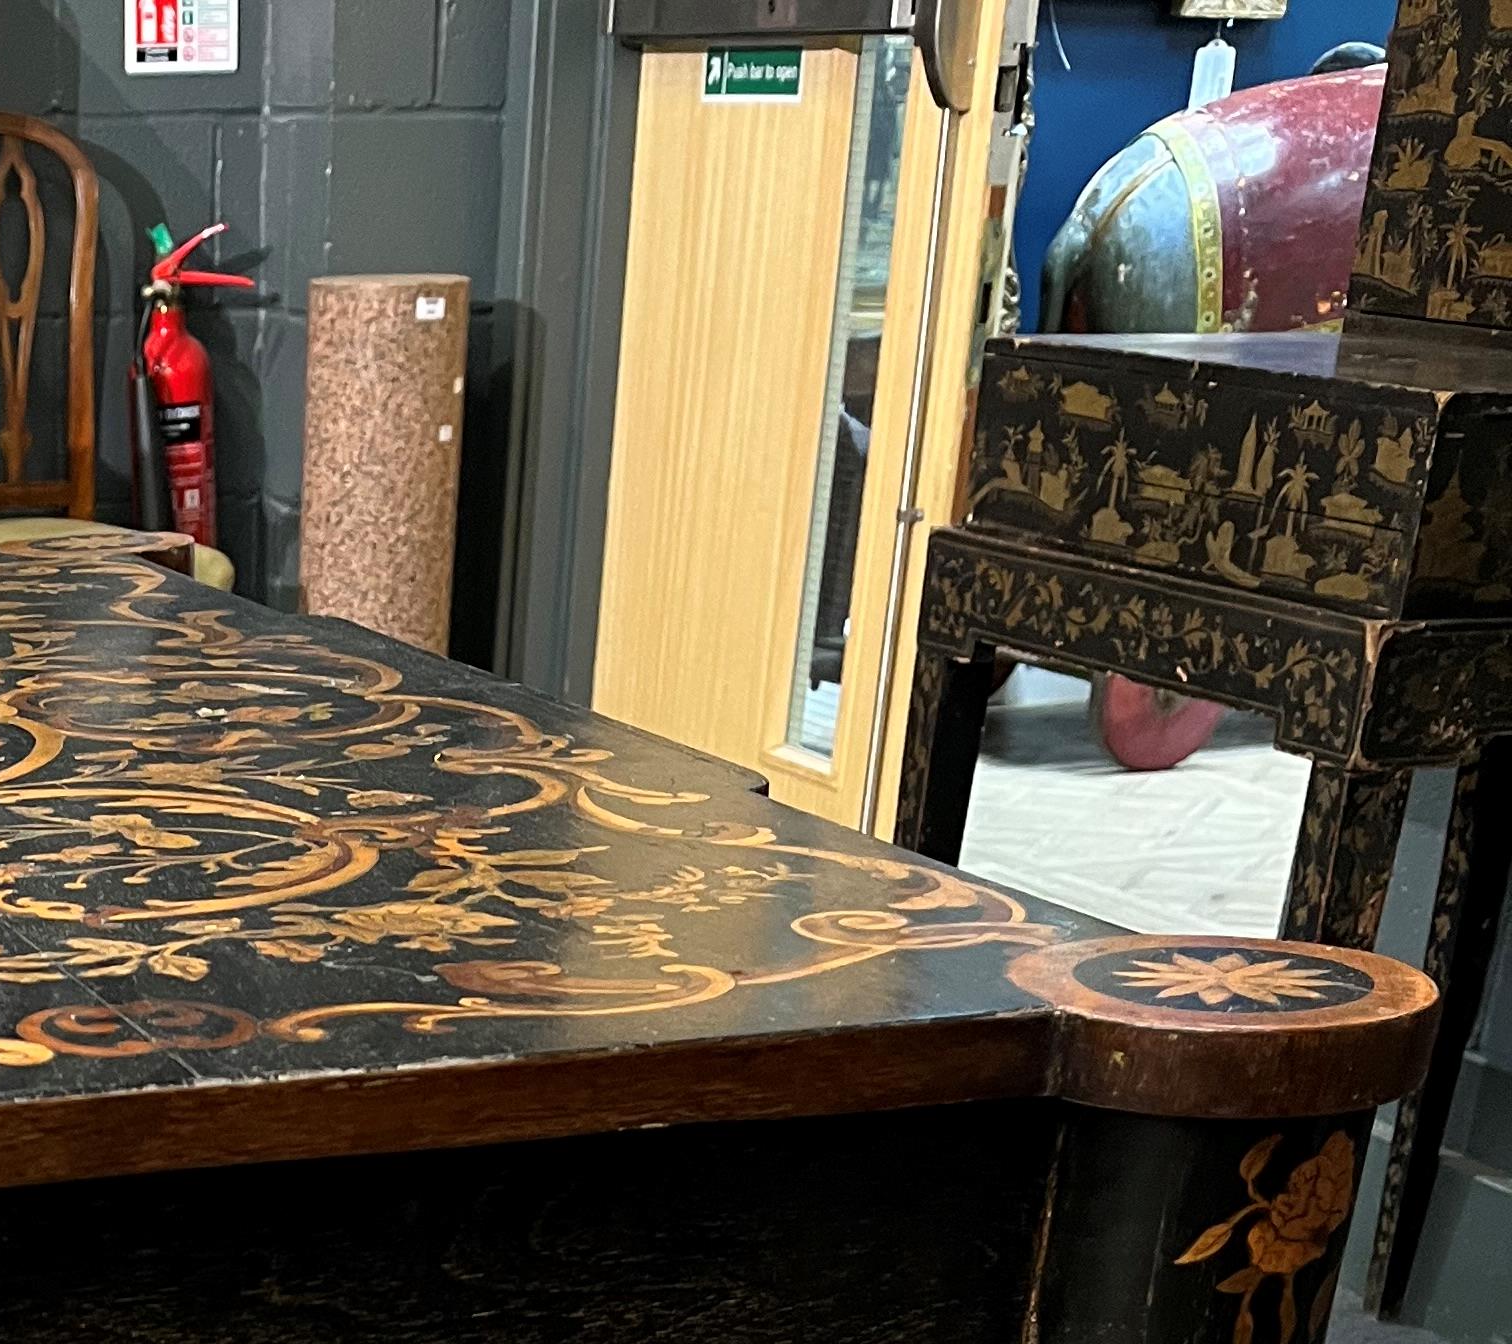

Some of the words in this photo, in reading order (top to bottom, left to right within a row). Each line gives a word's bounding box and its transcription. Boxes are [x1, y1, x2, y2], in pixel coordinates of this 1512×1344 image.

[727, 61, 748, 79] Push
[750, 61, 763, 79] bar
[765, 63, 774, 79] to
[776, 65, 797, 82] open
